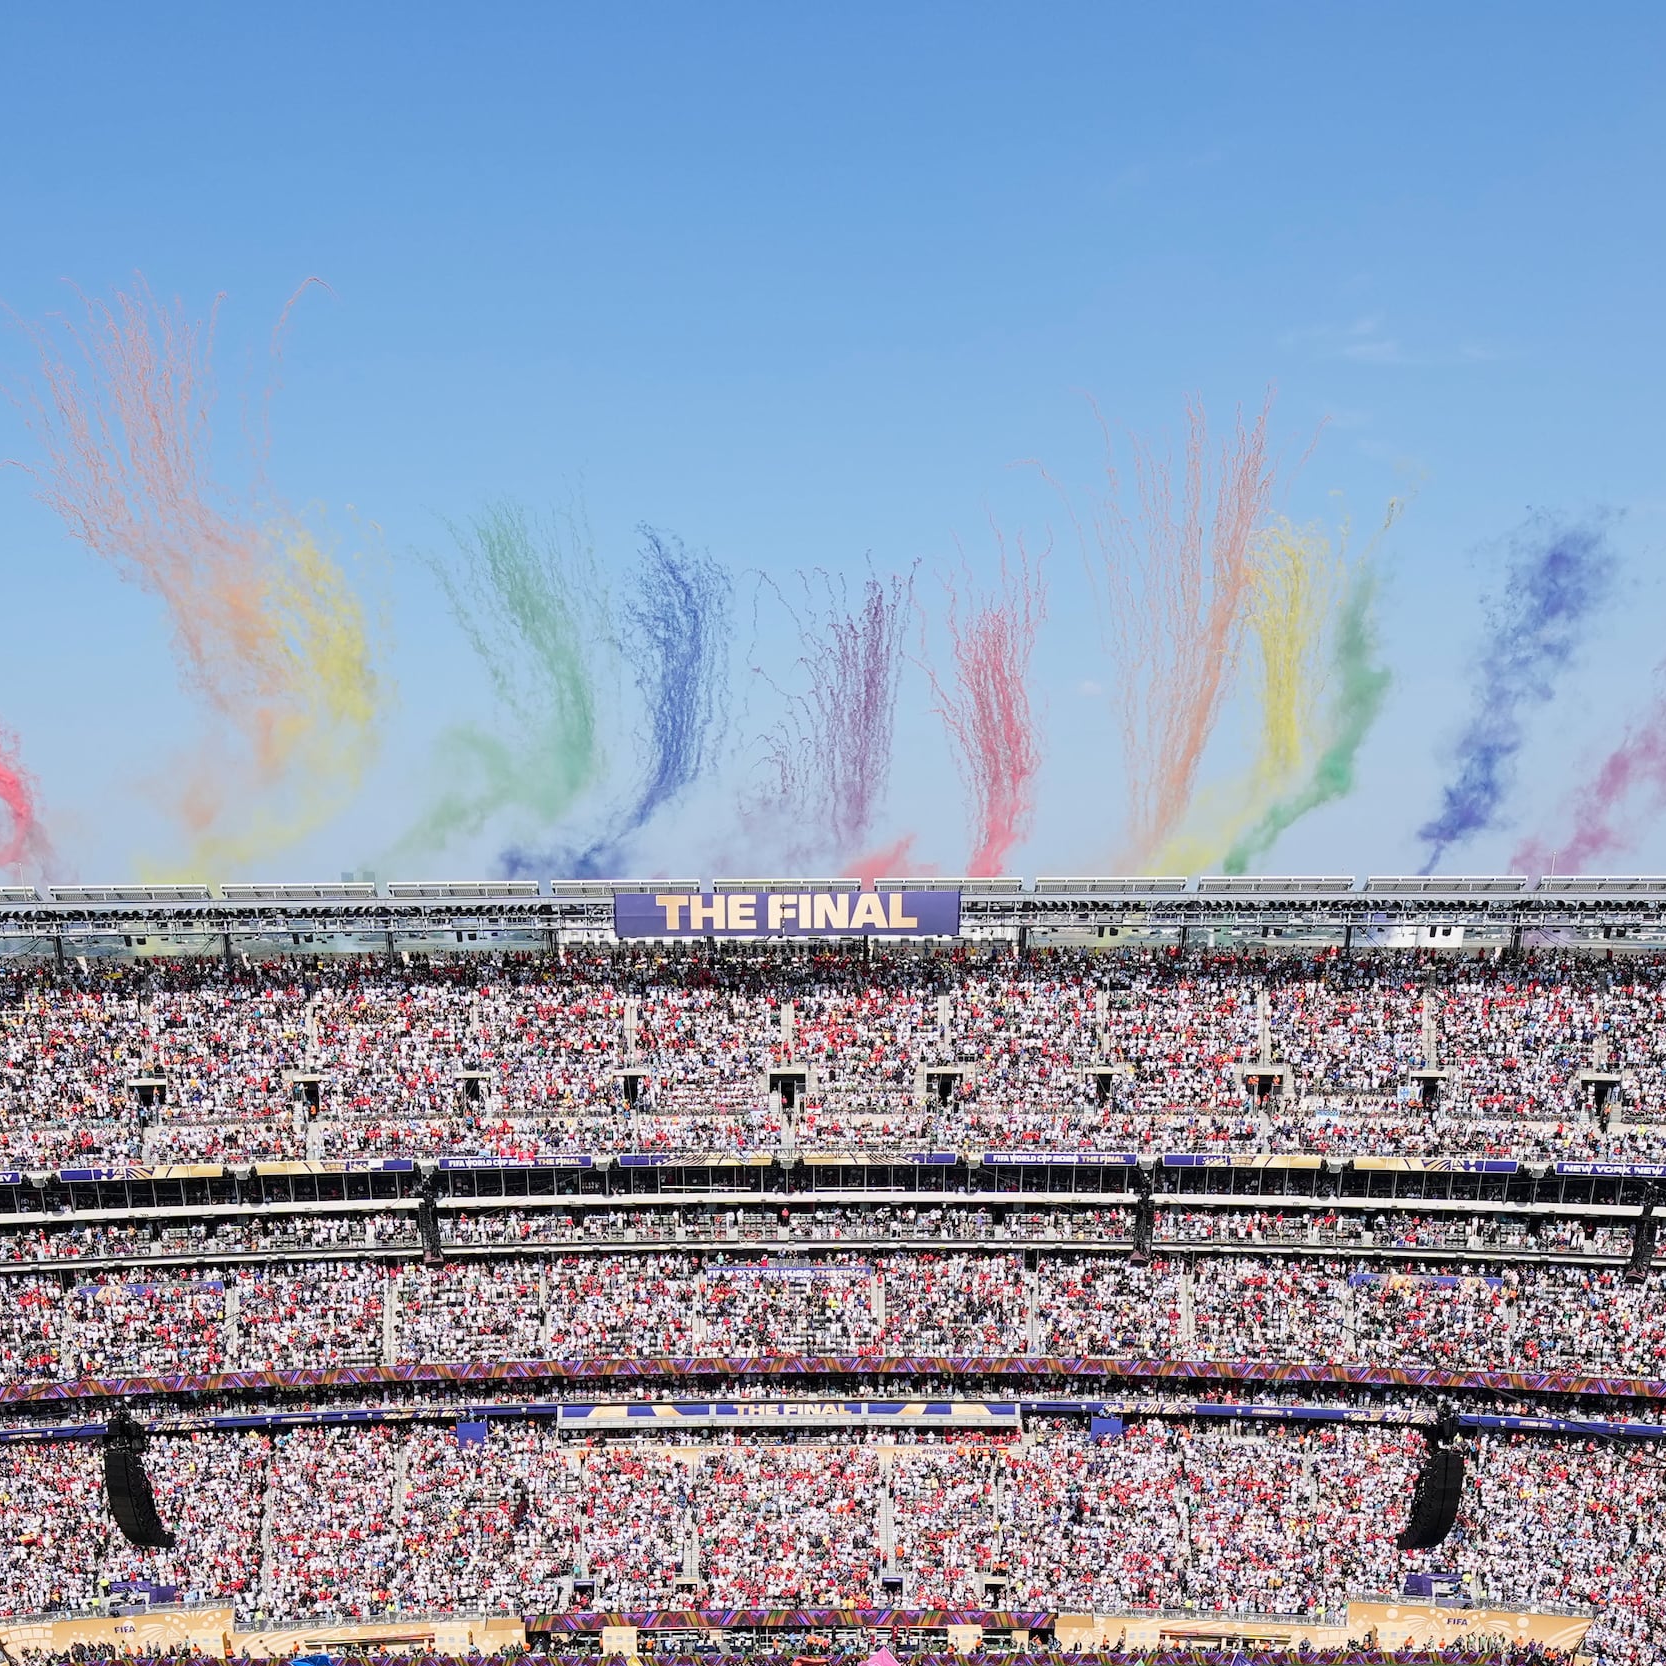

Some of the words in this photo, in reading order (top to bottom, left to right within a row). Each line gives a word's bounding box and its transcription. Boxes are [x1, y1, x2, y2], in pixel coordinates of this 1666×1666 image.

[655, 895, 757, 930] THE
[767, 893, 918, 930] FINAL
[448, 1160, 468, 1168] FIFA
[468, 1159, 492, 1168] WORLD
[492, 1159, 507, 1167] CUP
[536, 1158, 554, 1167] THE
[555, 1158, 582, 1166] FINAL
[1563, 1164, 1592, 1173] NEW
[1595, 1165, 1632, 1174] YORK
[1634, 1166, 1662, 1175] NEW
[733, 1404, 779, 1415] THE
[783, 1403, 852, 1415] FINAL
[1446, 1617, 1468, 1626] FIFA
[114, 1625, 135, 1634] FIFA
